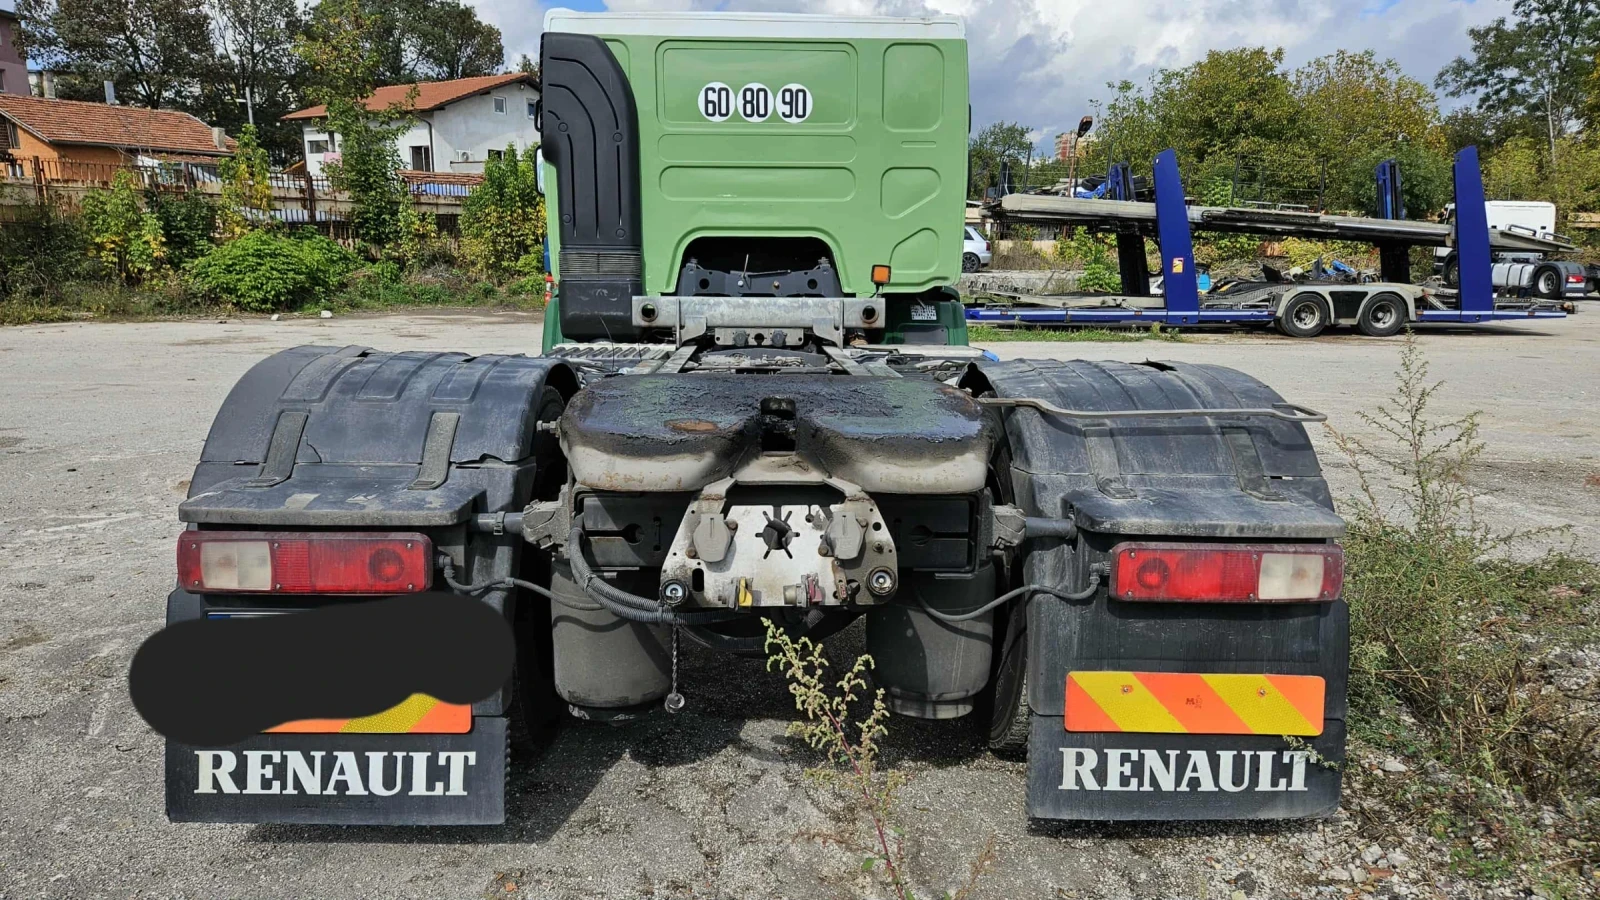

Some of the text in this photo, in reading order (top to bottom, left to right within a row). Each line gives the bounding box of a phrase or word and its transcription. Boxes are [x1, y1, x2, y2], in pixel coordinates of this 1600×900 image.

[704, 87, 807, 119] 60 80 90
[193, 750, 477, 797] RENAULT
[1058, 747, 1317, 793] RENAULT
